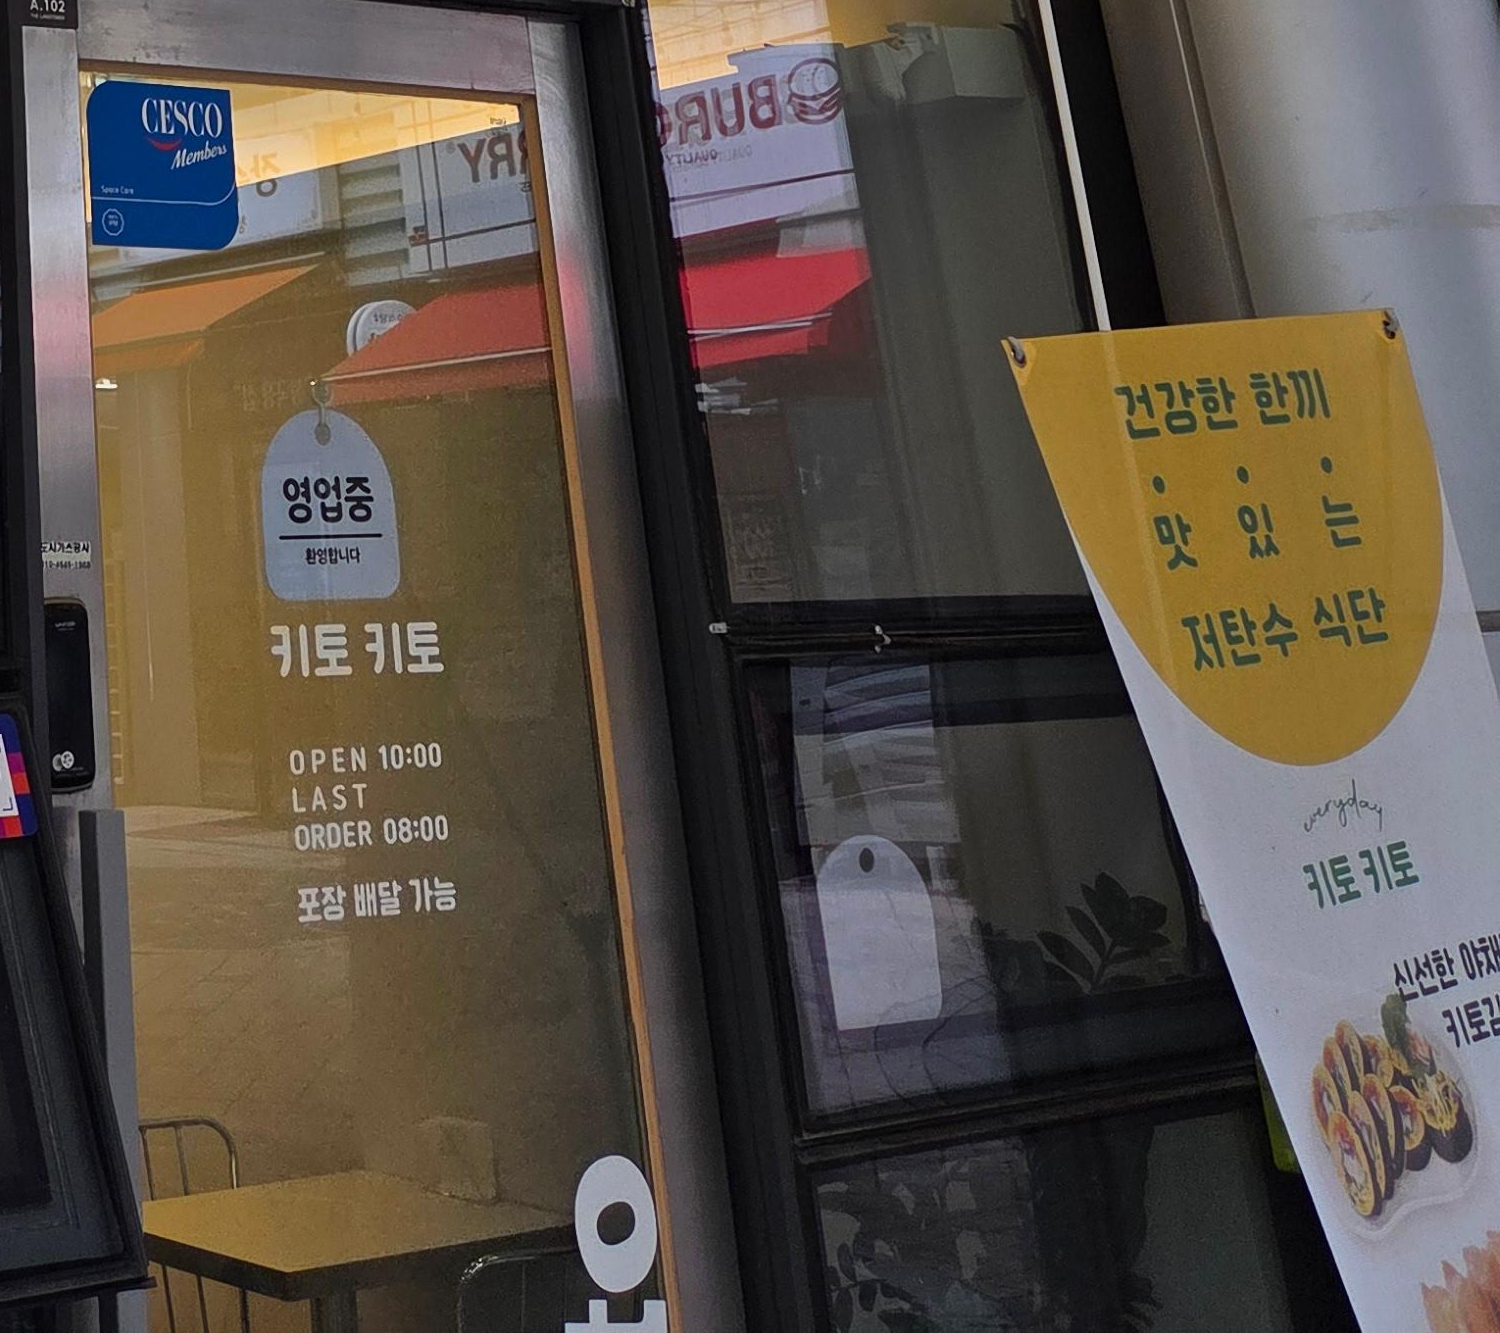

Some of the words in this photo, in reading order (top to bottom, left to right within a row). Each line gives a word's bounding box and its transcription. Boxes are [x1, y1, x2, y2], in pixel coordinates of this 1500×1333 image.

[141, 97, 223, 139] CESCO
[170, 140, 228, 171] Members
[1114, 375, 1238, 439] 건강한
[1249, 368, 1331, 425] 한끼
[282, 476, 375, 524] 영업중
[304, 546, 361, 566] 환영합니다
[269, 623, 354, 678] 키토
[364, 620, 445, 674] 키토
[1181, 603, 1298, 672] 저탄수
[1313, 587, 1388, 647] 식단
[289, 746, 368, 775] OPEN
[378, 742, 442, 770] 10:00
[292, 783, 367, 813] LAST
[1304, 779, 1383, 832] everyday
[294, 821, 372, 851] ORDER
[383, 815, 449, 844] 08:00
[1303, 853, 1362, 909] 키토
[1358, 840, 1420, 892] 키토
[297, 884, 346, 923] 포장
[354, 881, 401, 918] 배달
[409, 877, 457, 912] 가능
[1393, 947, 1458, 1002] 신선한
[1458, 933, 1500, 981] 야채
